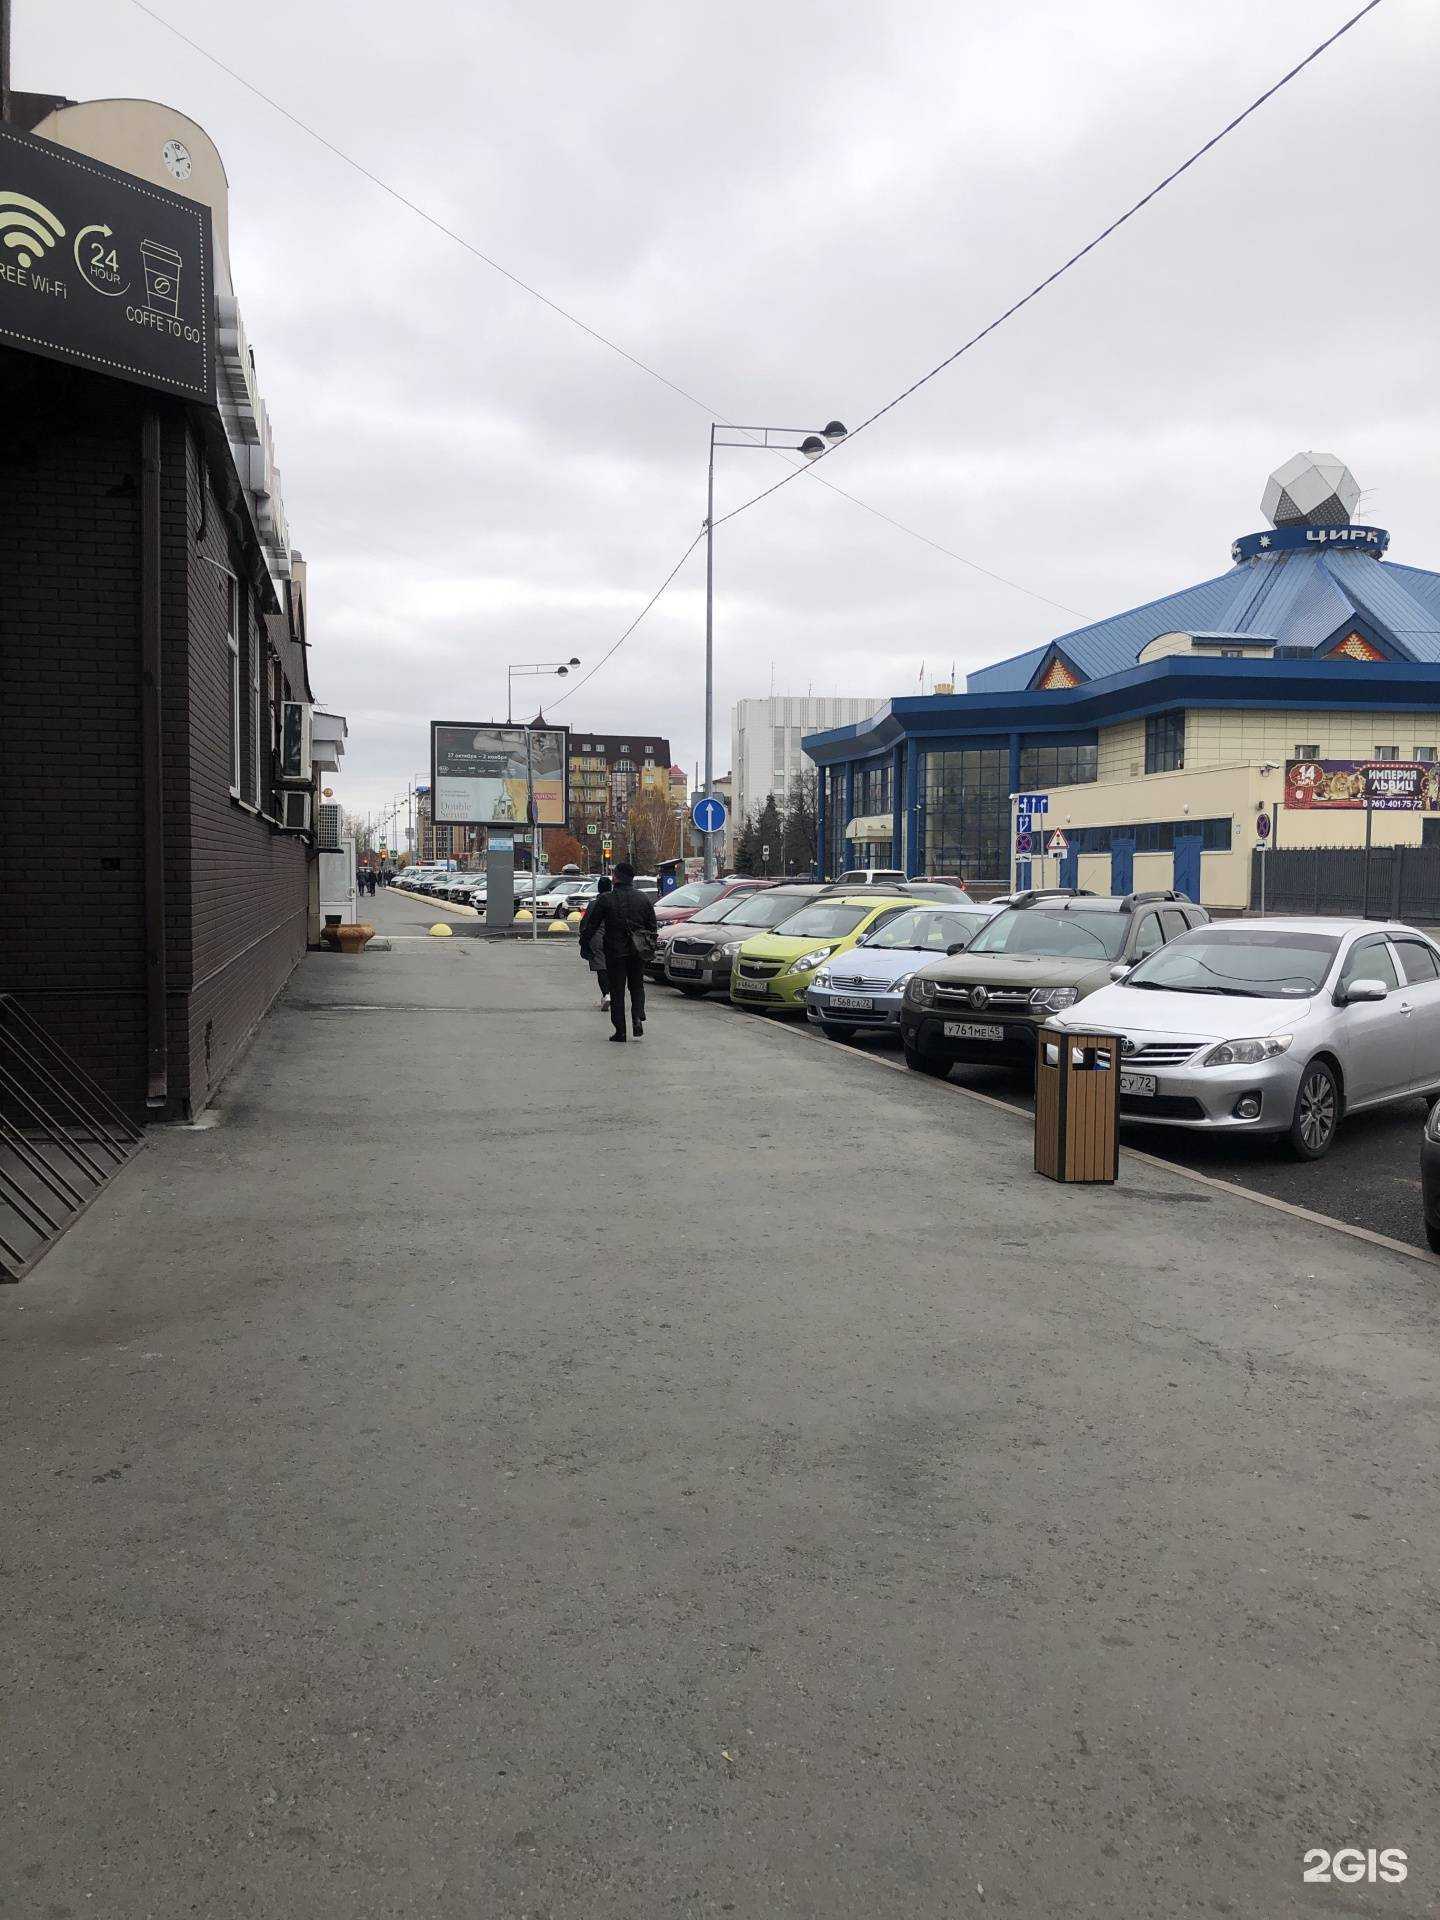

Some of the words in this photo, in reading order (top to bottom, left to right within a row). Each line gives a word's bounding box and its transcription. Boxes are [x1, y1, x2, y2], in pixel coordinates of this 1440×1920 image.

[90, 242, 119, 272] 24
[90, 266, 121, 285] HOUR
[32, 273, 67, 299] Wi-Fi
[126, 306, 164, 332] COFFE
[167, 319, 182, 337] TO
[183, 326, 201, 343] GO
[1306, 529, 1379, 544] ЦИРК
[1299, 765, 1315, 780] 14
[1368, 769, 1417, 780] ИМПЕРИЯ
[1372, 780, 1414, 791] ЛЬВИЦ
[1139, 1076, 1151, 1088] 72
